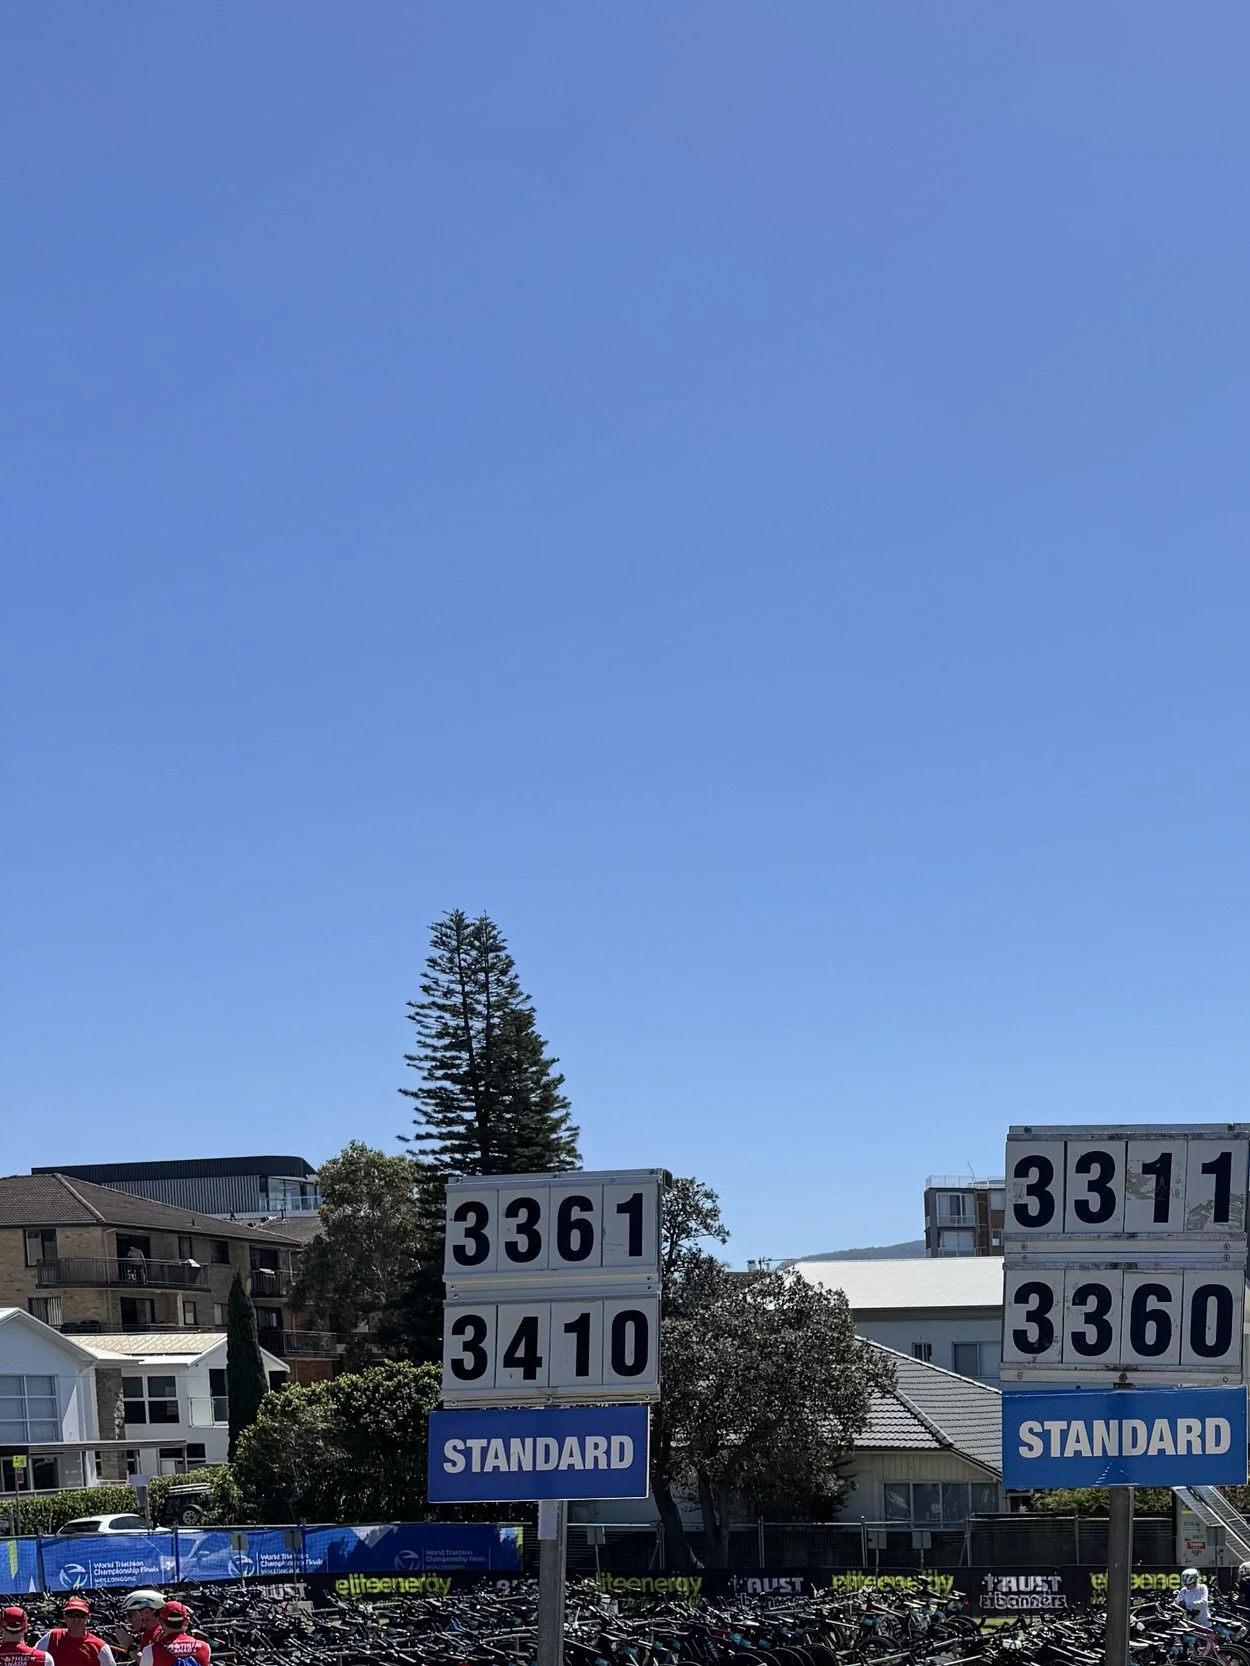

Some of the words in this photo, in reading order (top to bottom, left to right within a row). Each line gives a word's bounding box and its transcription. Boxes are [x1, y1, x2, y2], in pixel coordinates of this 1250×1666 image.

[1012, 1150, 1233, 1229] 3311
[452, 1193, 643, 1267] 3361
[450, 1309, 649, 1381] 3410
[1012, 1281, 1234, 1358] 3360
[442, 1435, 634, 1474] STANDARD
[1018, 1417, 1231, 1459] STANDARD
